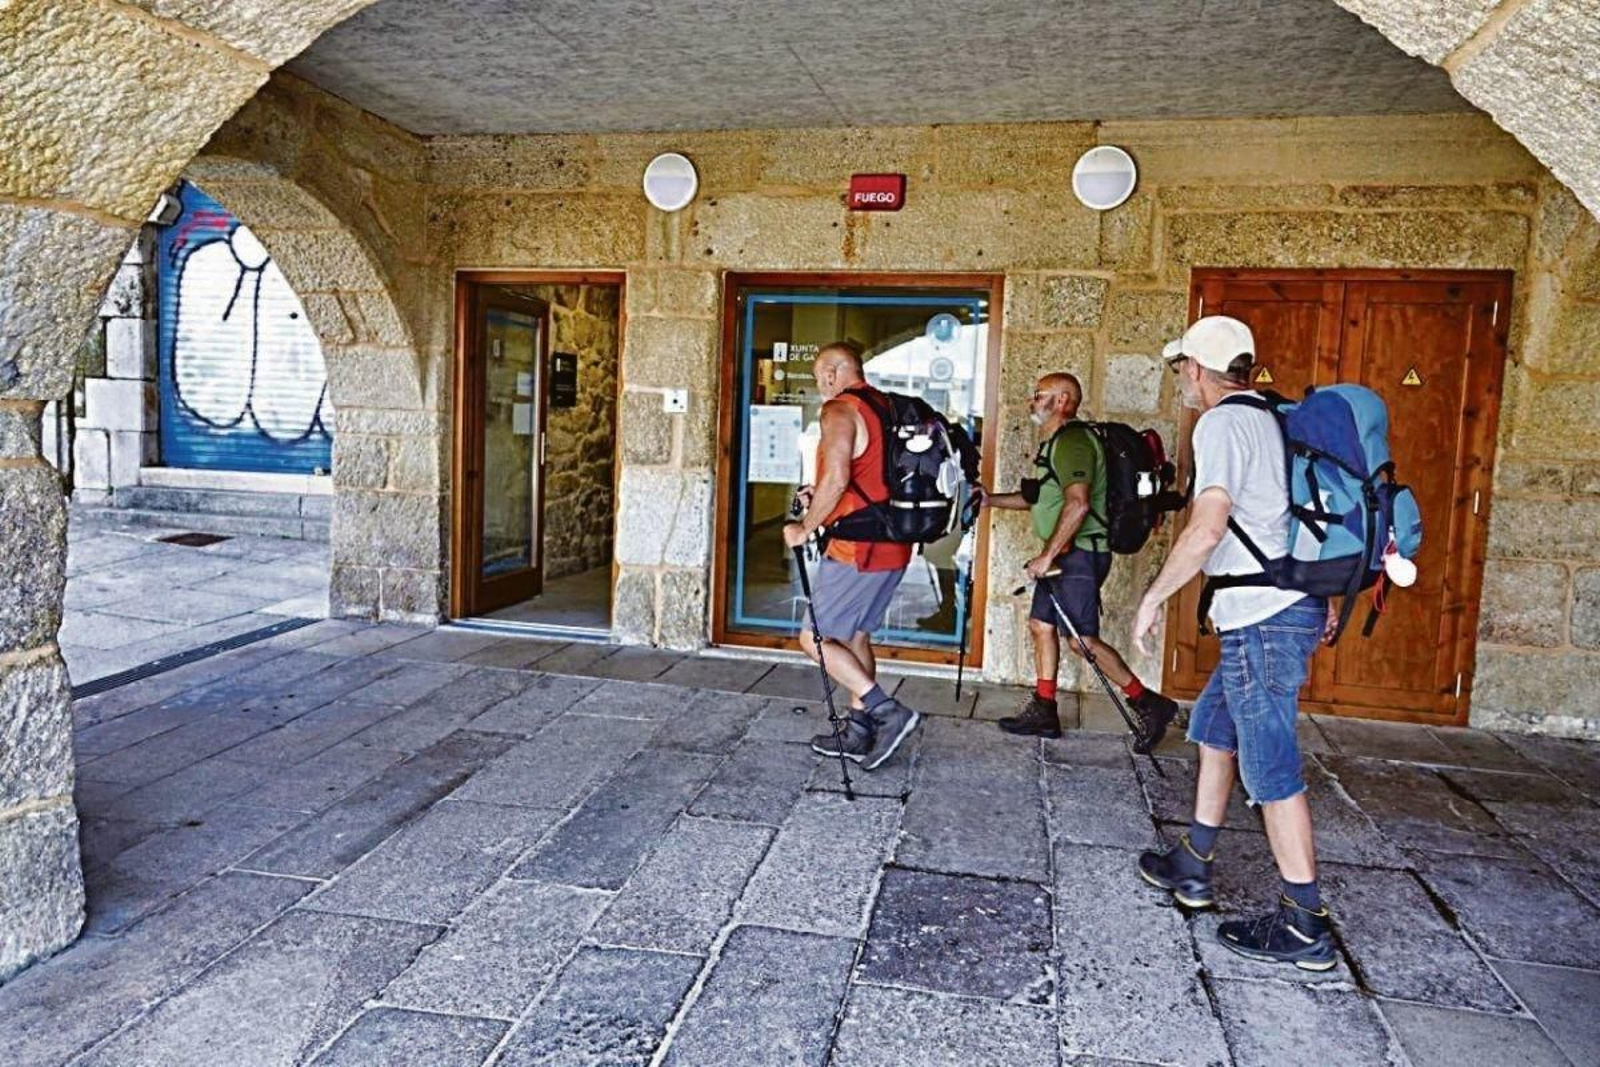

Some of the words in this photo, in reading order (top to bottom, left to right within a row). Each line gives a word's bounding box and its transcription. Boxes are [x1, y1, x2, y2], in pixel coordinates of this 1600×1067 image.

[854, 192, 895, 203] FUEGO
[790, 344, 820, 353] XUNTA
[789, 353, 800, 361] DE
